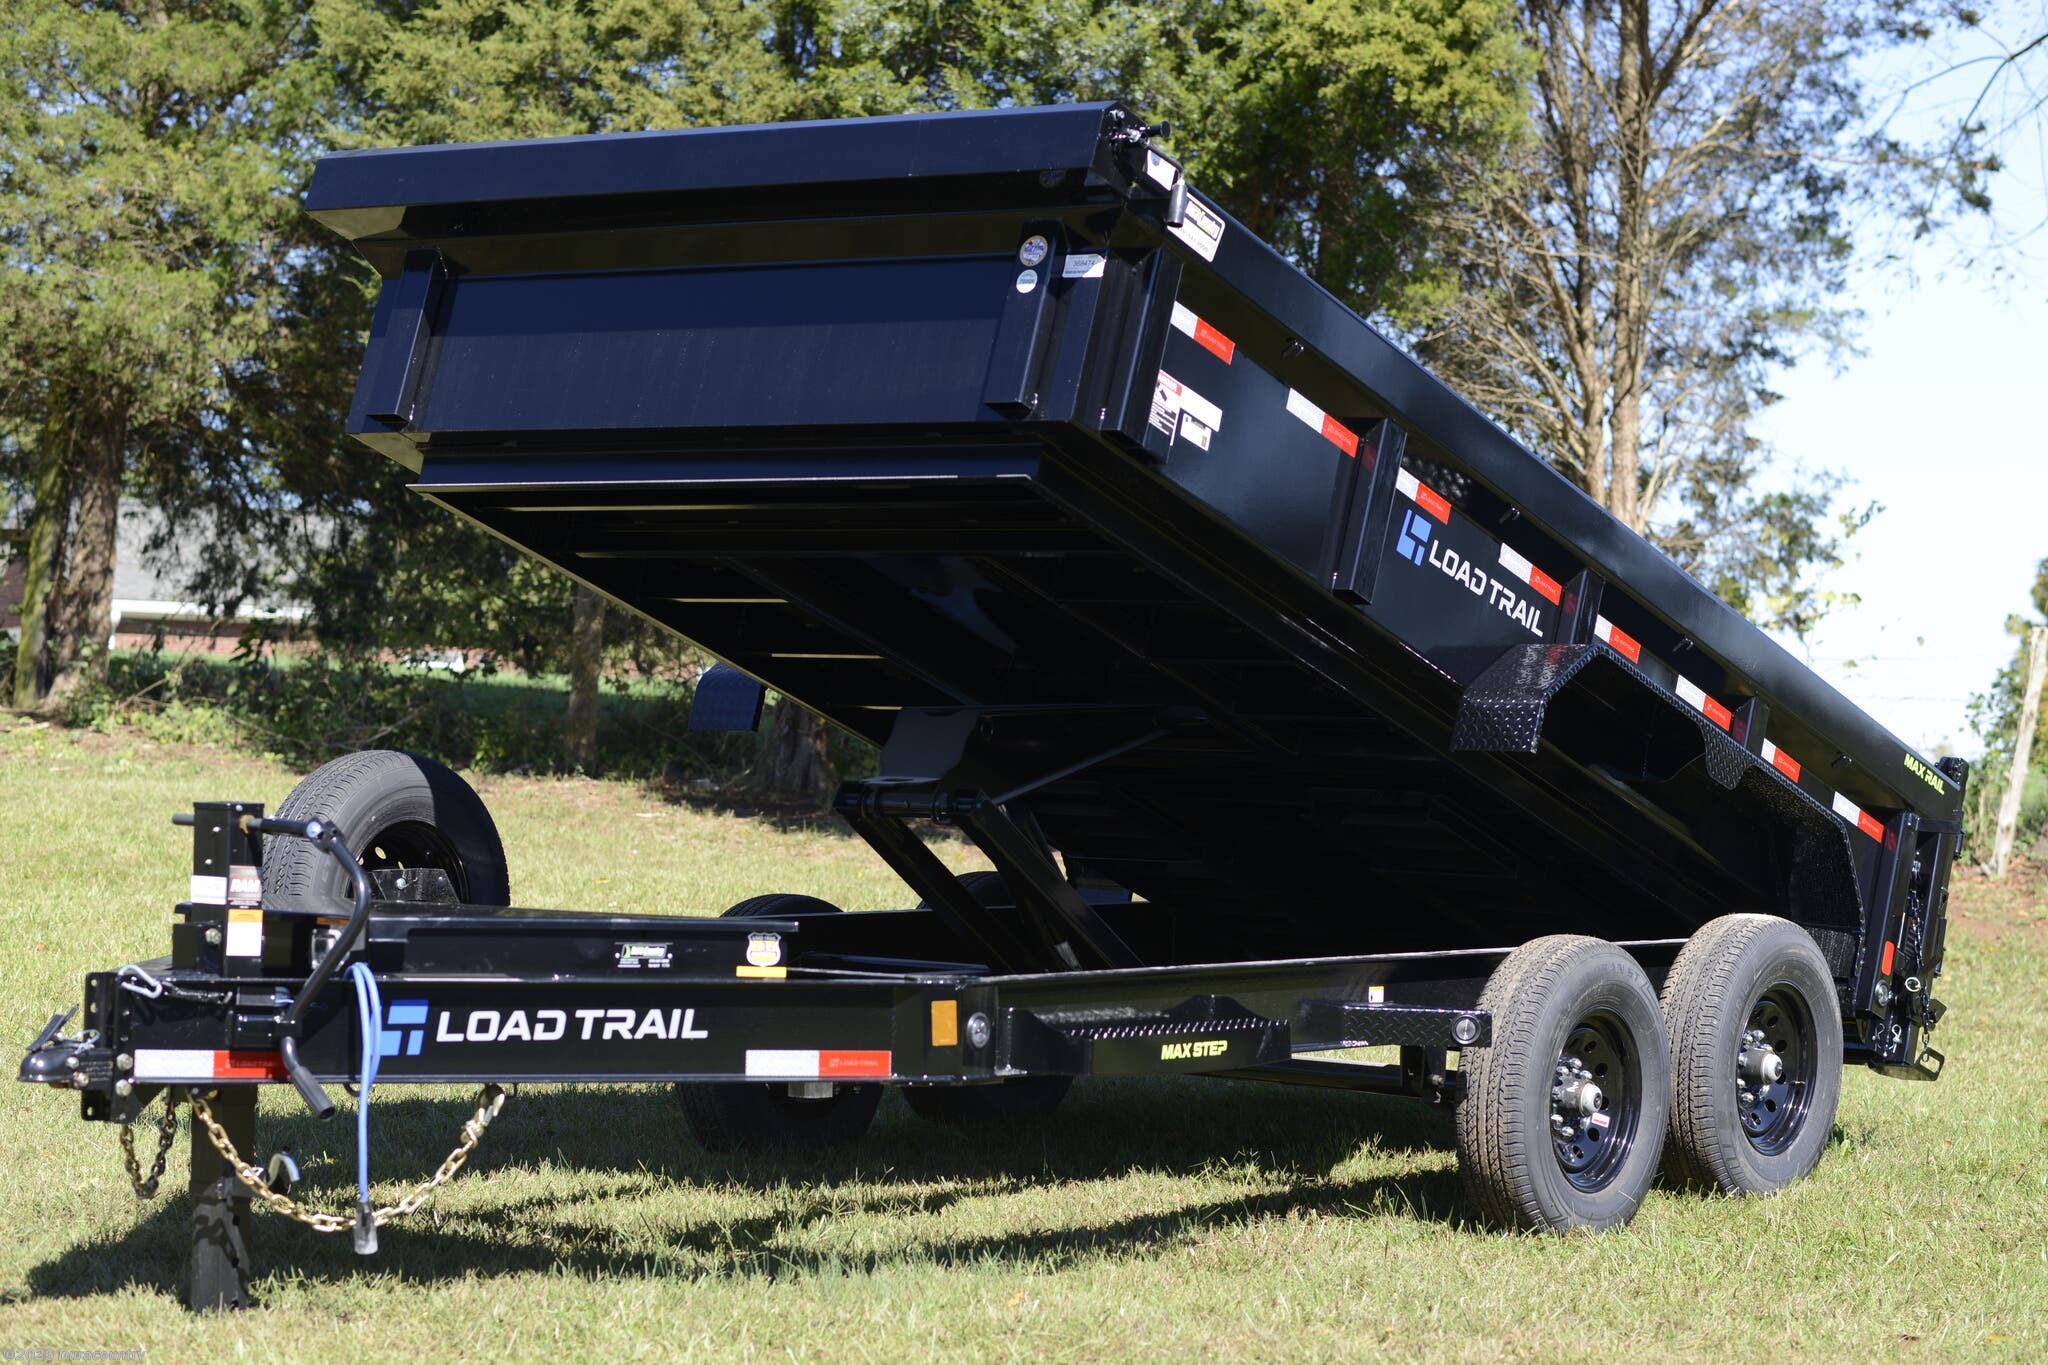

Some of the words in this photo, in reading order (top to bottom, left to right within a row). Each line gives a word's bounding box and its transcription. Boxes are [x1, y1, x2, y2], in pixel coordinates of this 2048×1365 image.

[1428, 539, 1487, 596] LOAD
[1489, 578, 1544, 638] TRAIL
[1904, 753, 1926, 779] MAX
[1925, 769, 1945, 796] RAIL
[436, 1010, 567, 1043] LOAD
[574, 1008, 709, 1040] TRAIL
[1160, 1043, 1193, 1060] MAX
[1192, 1040, 1228, 1058] STEP
